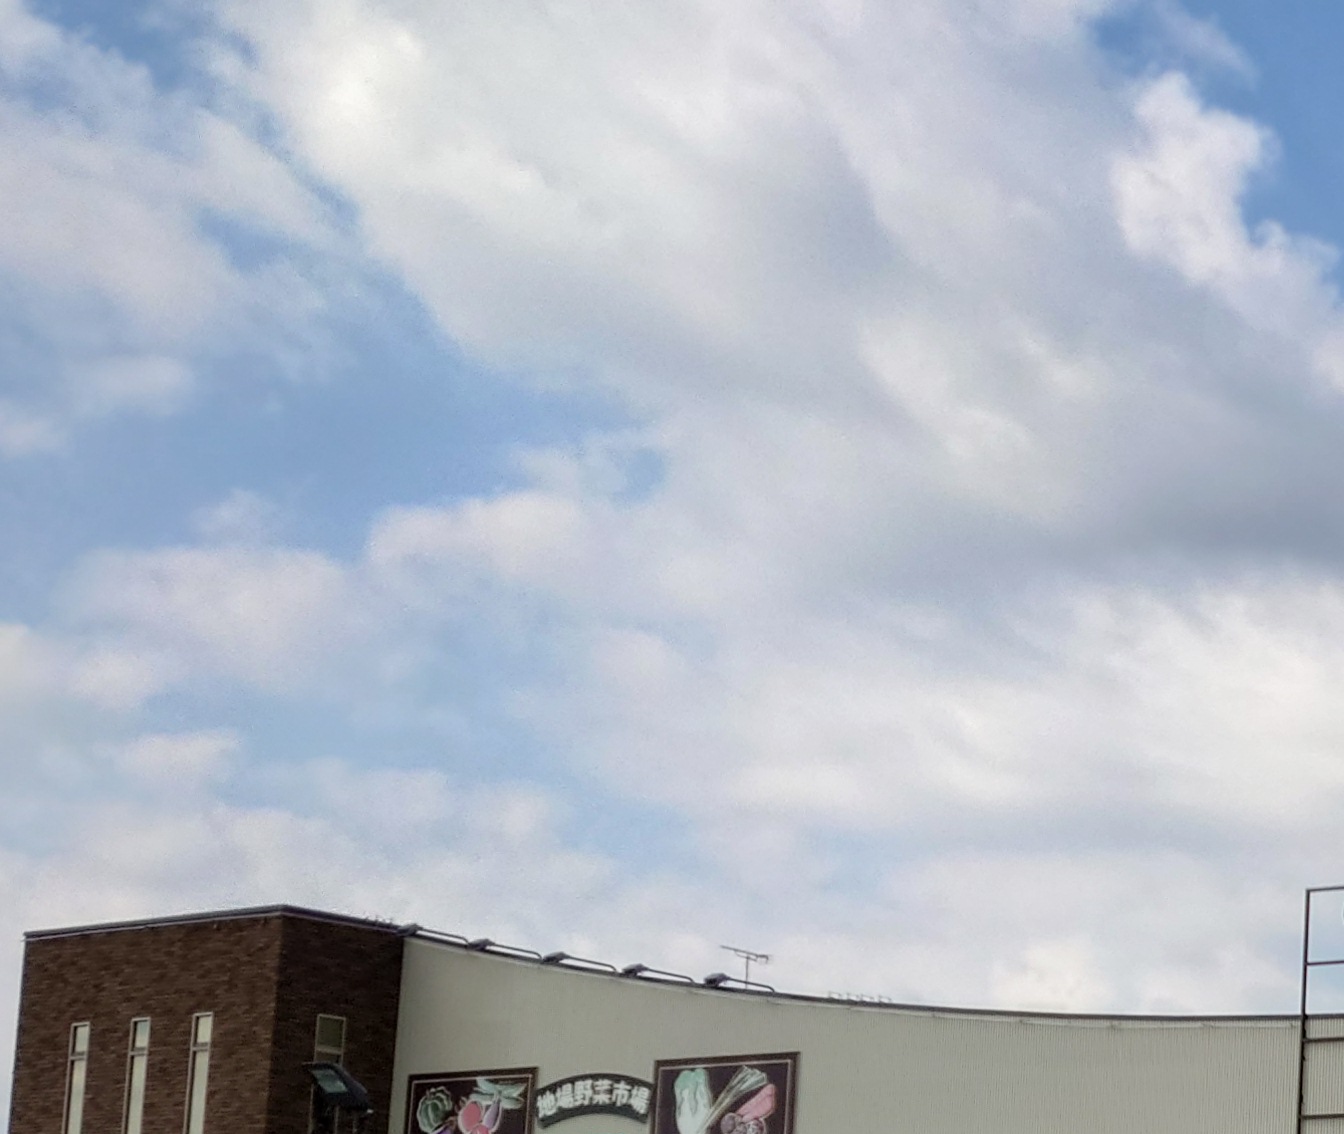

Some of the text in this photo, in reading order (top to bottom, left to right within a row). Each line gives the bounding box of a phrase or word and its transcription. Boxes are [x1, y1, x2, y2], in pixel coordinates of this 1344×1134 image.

[537, 1079, 651, 1117] 地場野菜市場
